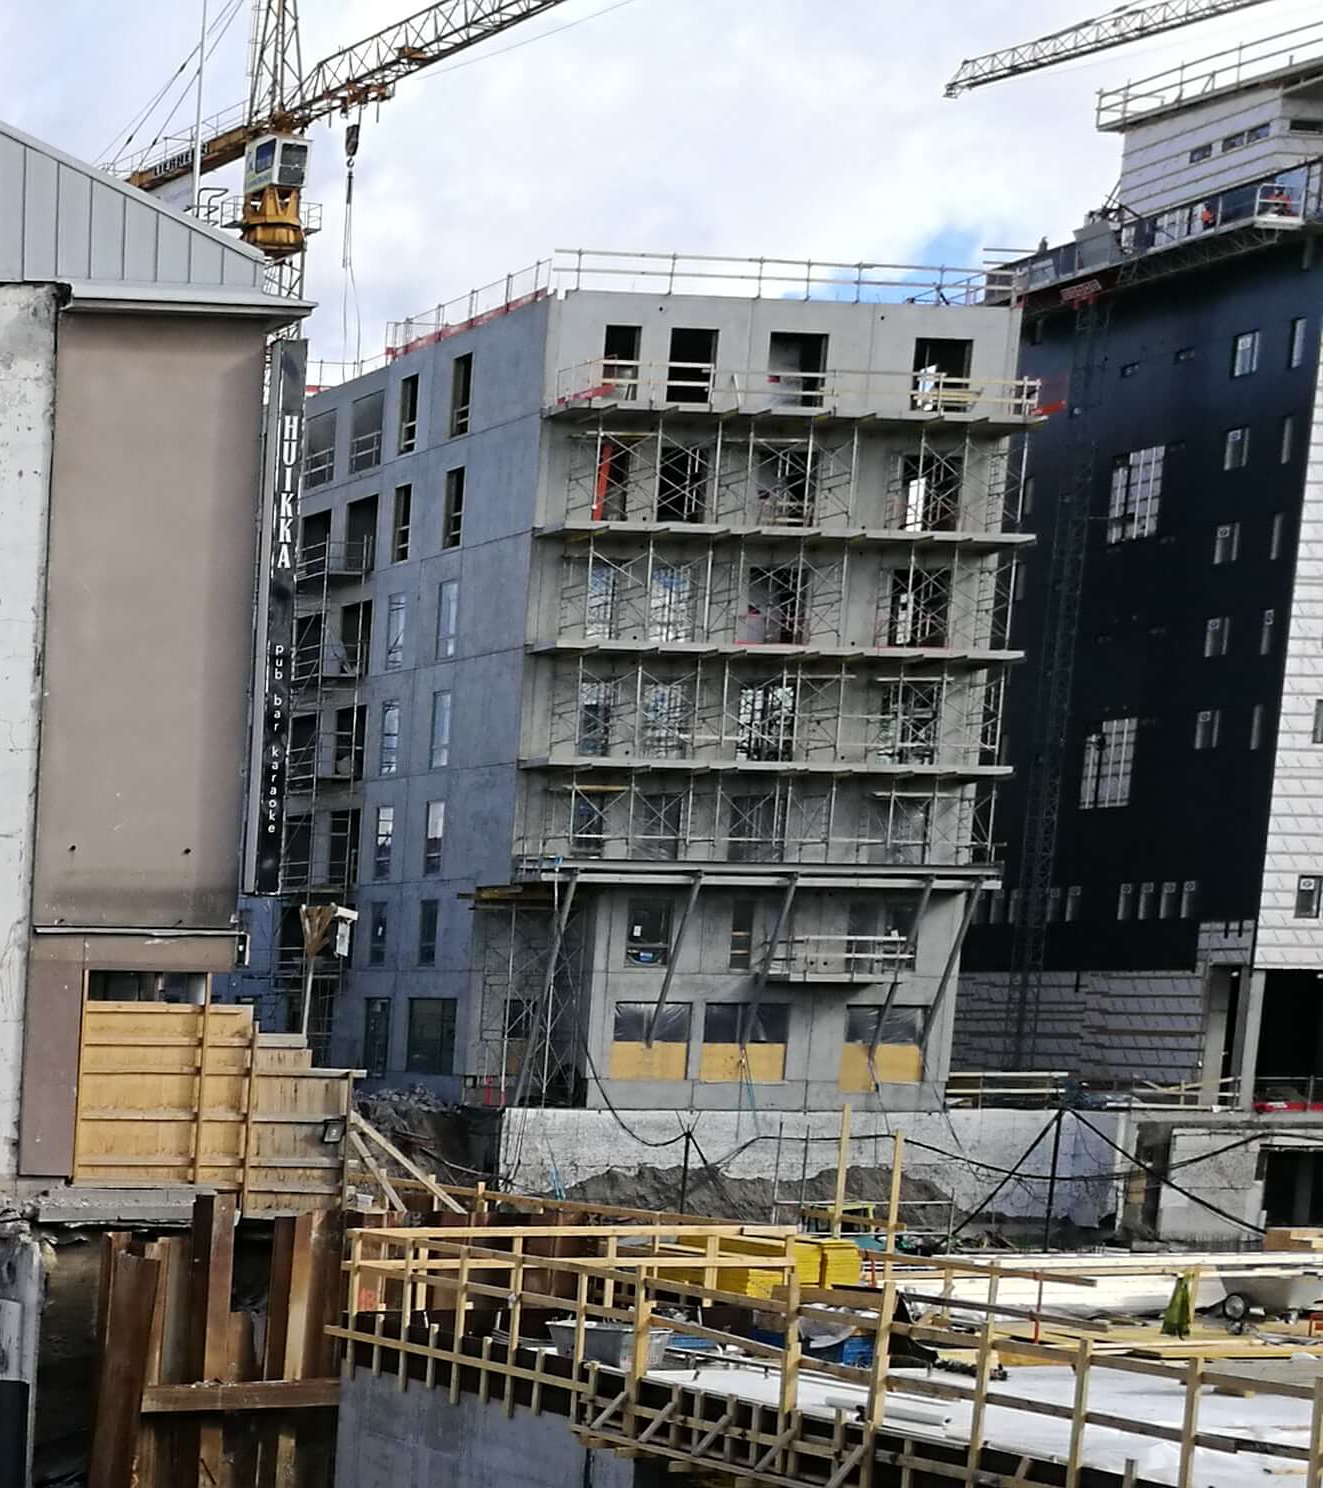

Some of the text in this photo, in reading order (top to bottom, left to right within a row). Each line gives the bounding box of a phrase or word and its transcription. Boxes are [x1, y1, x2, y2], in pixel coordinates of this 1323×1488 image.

[276, 415, 299, 569] HUIKKA
[267, 644, 284, 834] pub bar karaoke
